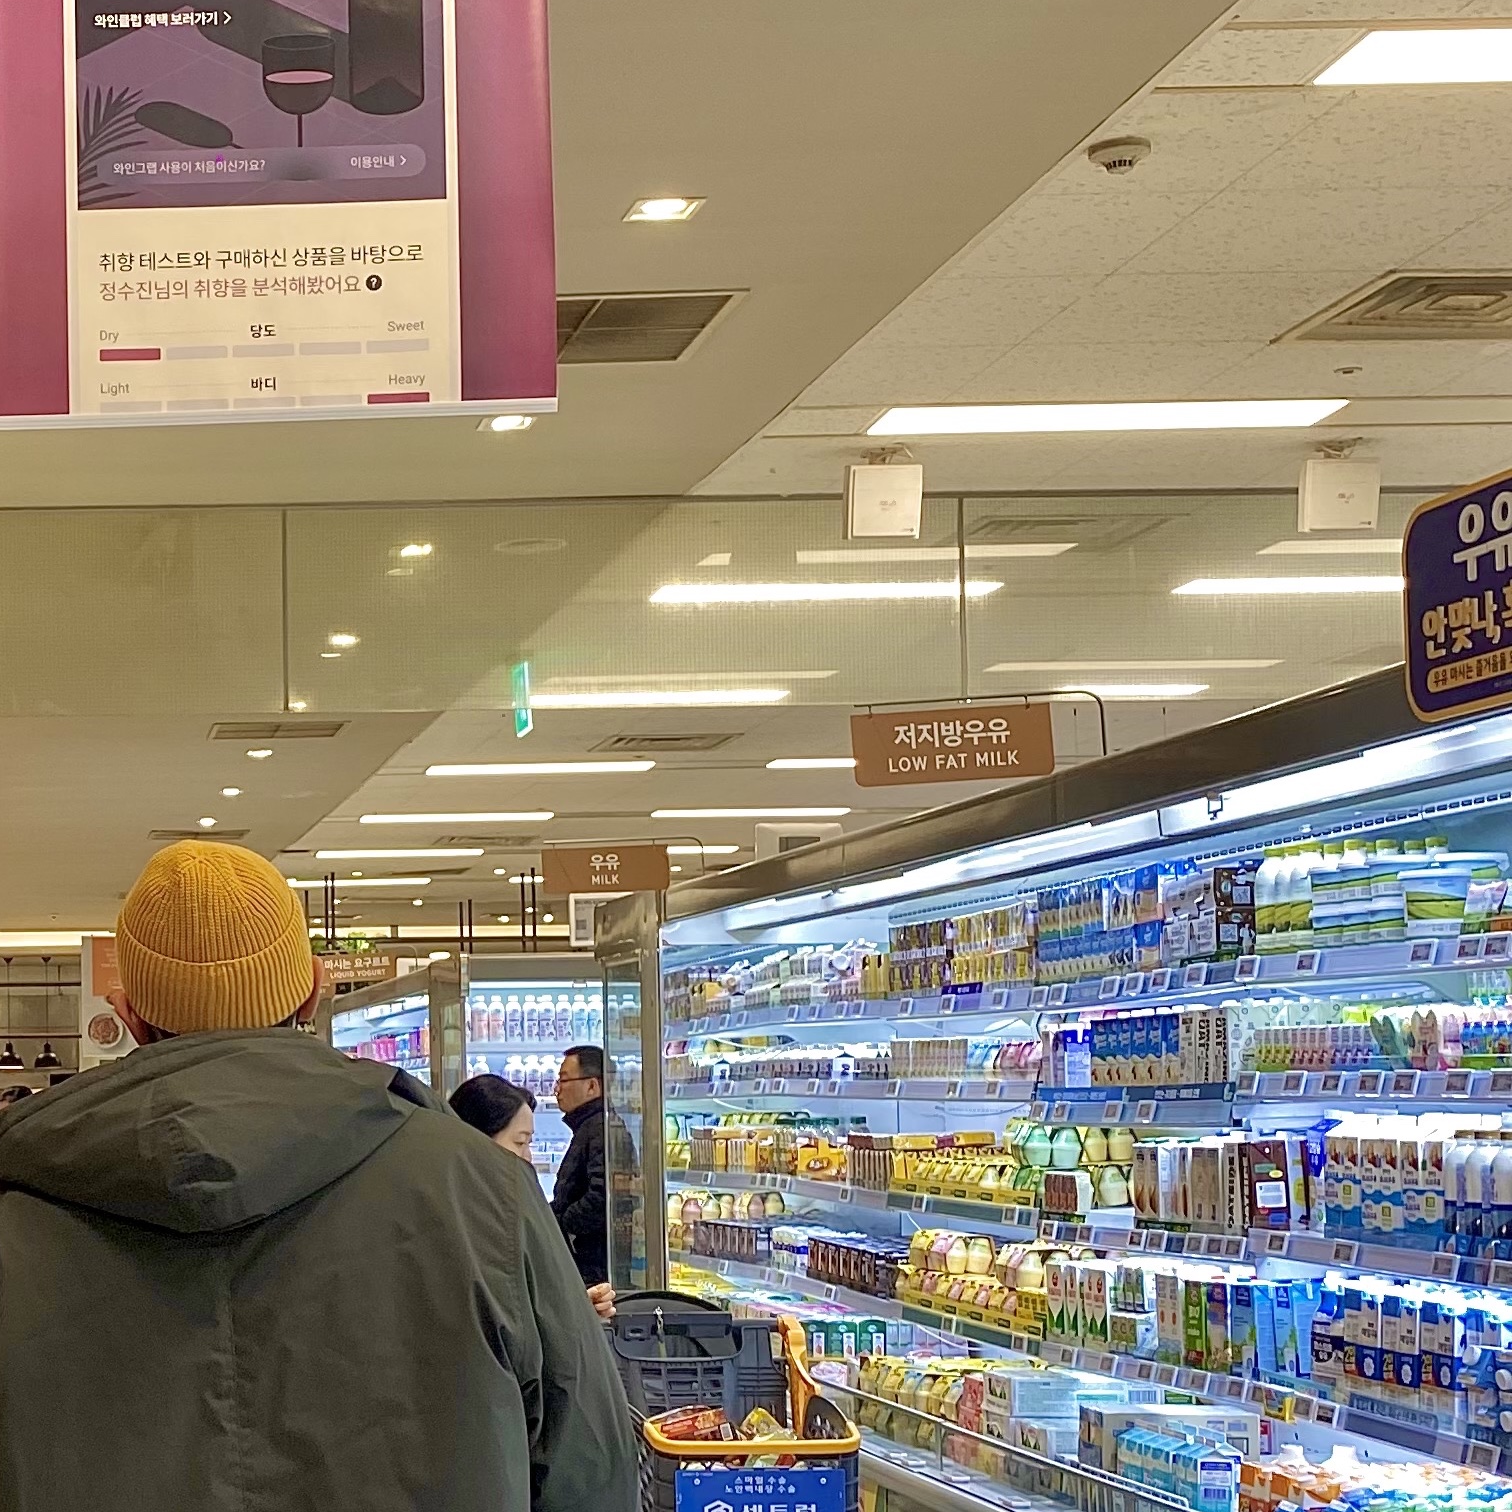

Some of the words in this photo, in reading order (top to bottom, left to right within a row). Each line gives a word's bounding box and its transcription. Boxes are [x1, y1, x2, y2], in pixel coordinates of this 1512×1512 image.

[94, 13, 142, 28] 와인클럽
[144, 13, 169, 27] 혜택
[170, 11, 218, 26] 보러가기
[113, 161, 157, 175] 와인그랩
[159, 161, 192, 174] 사용이
[194, 159, 266, 174] 처음이신가요?
[99, 253, 135, 272] 취향
[139, 251, 212, 271] 테스트와
[215, 249, 289, 269] 구매하신
[291, 246, 347, 267] 상품을
[350, 244, 425, 265] 바탕으로
[99, 279, 190, 301] 정수진님의
[193, 277, 249, 299] 취향을
[251, 275, 363, 297] 분석해봤어요
[250, 324, 277, 338] 당도
[387, 320, 425, 332] Sweet
[99, 329, 120, 343] Dry
[251, 376, 277, 391] 바디
[388, 373, 426, 387] Heavy
[100, 381, 130, 396] Light
[1450, 664, 1473, 681] 마시는
[894, 718, 1010, 749] 저지방우유
[888, 756, 928, 773] LOW
[936, 753, 967, 769] FAT
[976, 750, 1020, 767] MILK
[590, 854, 620, 871] 우유
[591, 874, 619, 885] MILK
[330, 971, 354, 979] LIQUID
[357, 968, 386, 977] YOGURT
[734, 1476, 763, 1485] 스마일
[768, 1476, 787, 1485] 수술
